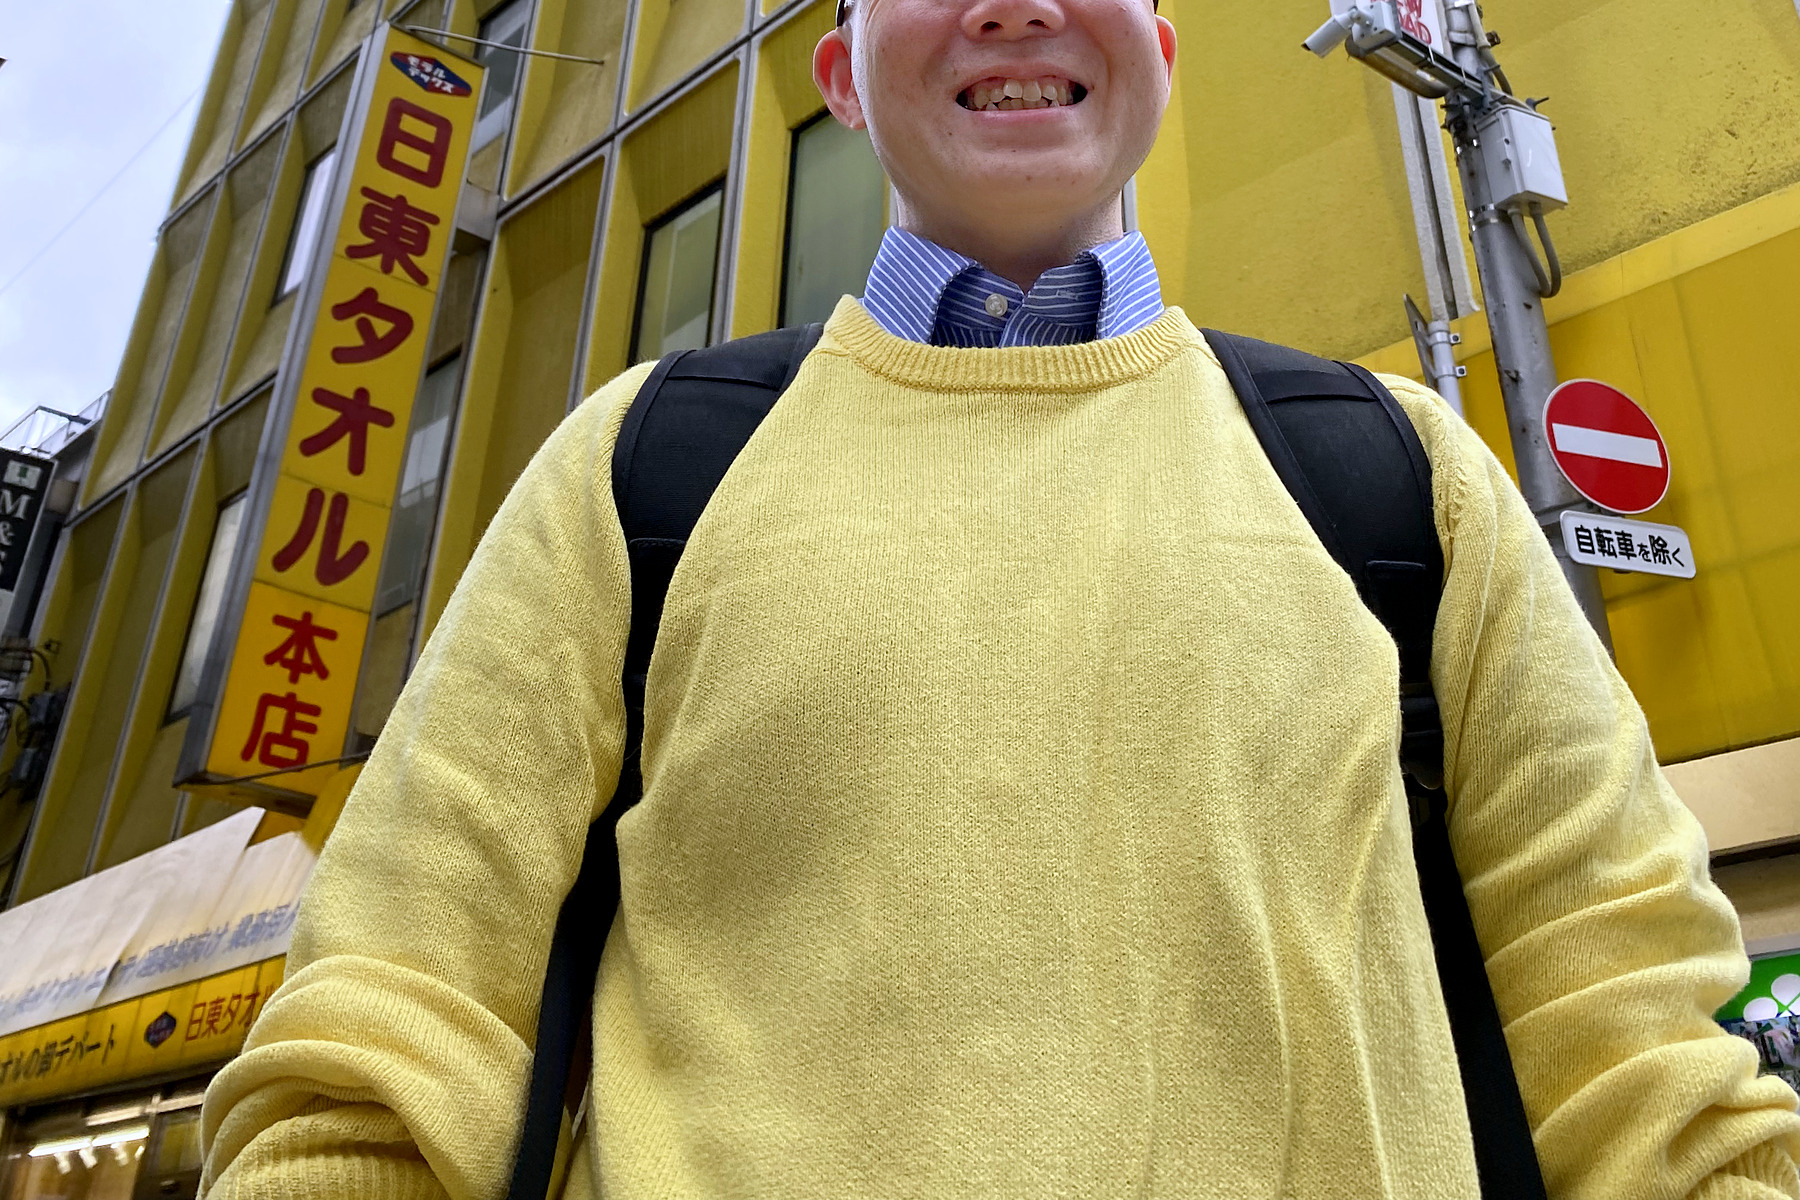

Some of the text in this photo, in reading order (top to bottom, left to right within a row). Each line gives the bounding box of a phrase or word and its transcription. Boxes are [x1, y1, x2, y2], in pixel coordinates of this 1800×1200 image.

[1574, 525, 1685, 567] 自転車を除く
